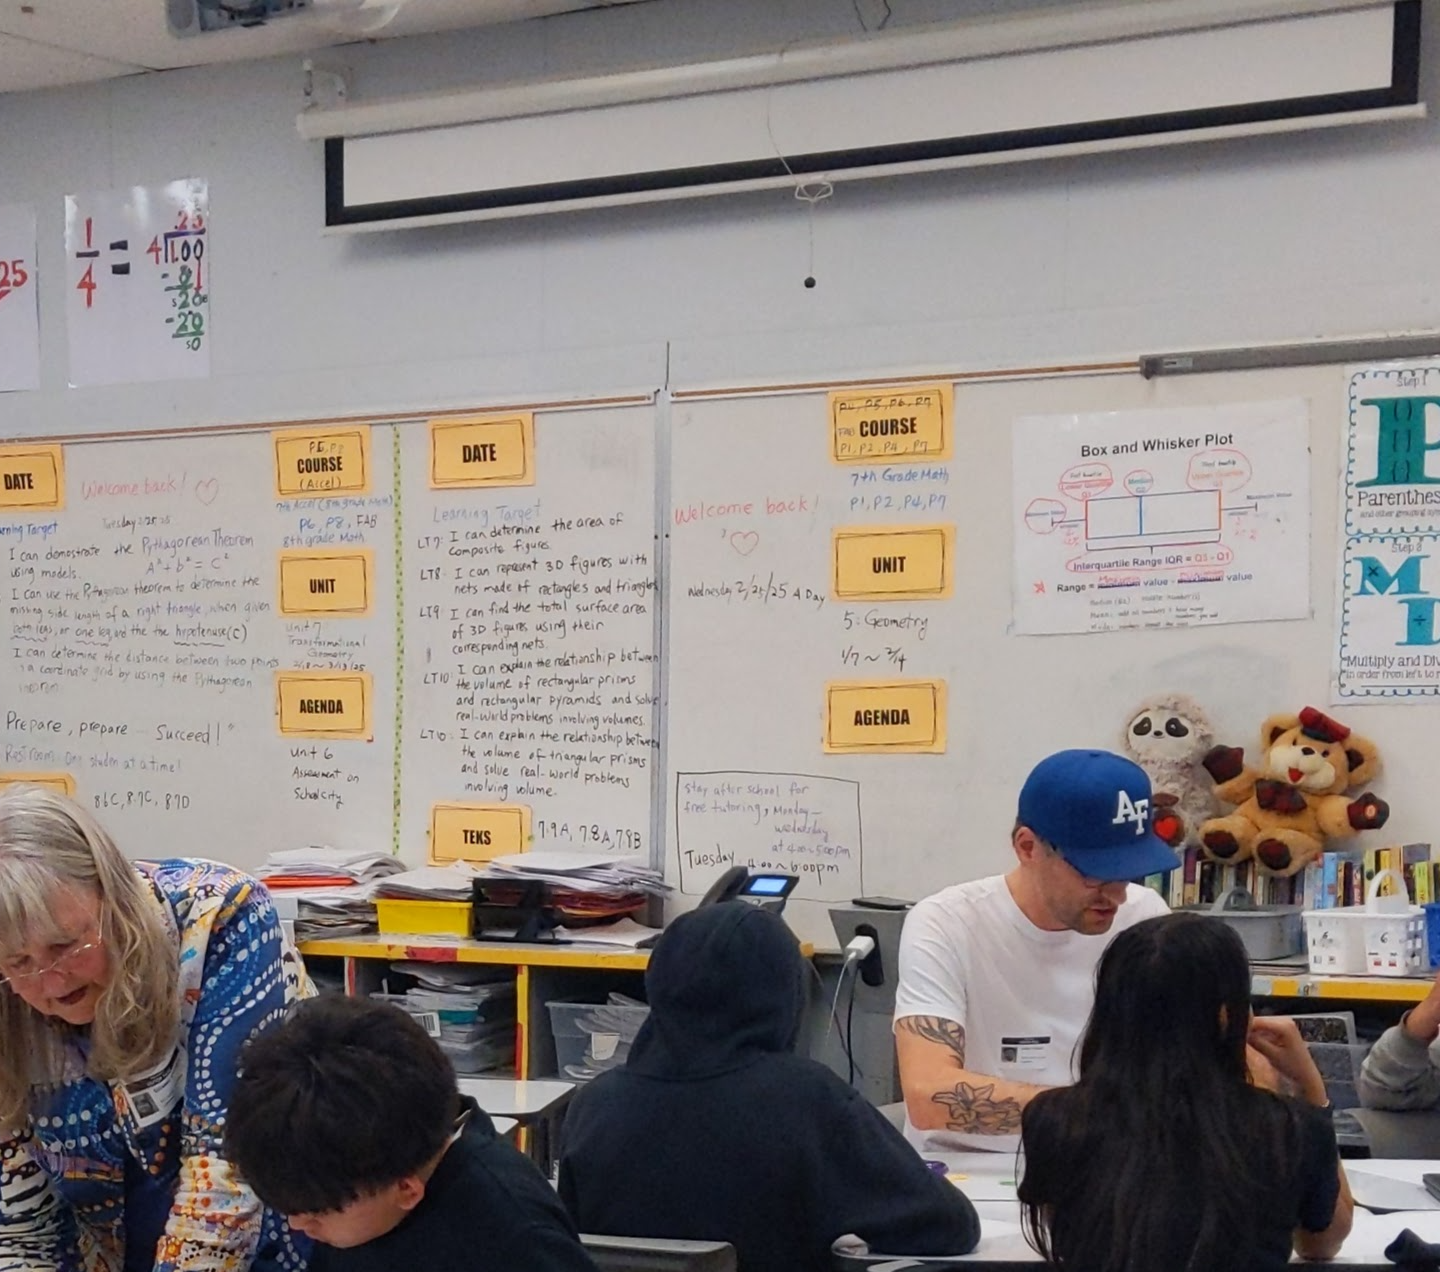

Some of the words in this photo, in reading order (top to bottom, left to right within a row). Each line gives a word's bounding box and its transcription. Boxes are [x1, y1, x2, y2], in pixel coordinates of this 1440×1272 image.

[76, 264, 97, 308] 4
[1396, 377, 1421, 388] Step
[859, 416, 917, 438] COURSE
[462, 443, 497, 464] DATE
[1081, 445, 1108, 457] Box
[1112, 441, 1139, 455] and
[1142, 435, 1200, 452] Whisker
[1205, 433, 1234, 447] Plot
[297, 456, 343, 474] COURSE
[3, 473, 34, 491] DATE
[881, 467, 919, 483] Grade
[920, 467, 950, 485] Math
[433, 506, 489, 528] Learning
[496, 498, 542, 524] Target
[674, 500, 754, 526] Welcome
[1376, 510, 1394, 518] other
[27, 522, 59, 541] Target
[465, 526, 487, 541] can
[490, 520, 541, 539] determine
[552, 517, 573, 531] the
[576, 518, 604, 529] area
[21, 551, 39, 562] can
[212, 527, 254, 548] Theorem
[305, 533, 335, 548] grade
[1391, 542, 1415, 555] Step
[468, 566, 490, 578] can
[497, 559, 539, 577] represent
[569, 554, 613, 576] figures
[618, 553, 648, 566] with
[872, 556, 907, 574] UNIT
[1073, 560, 1130, 572] Interquartile
[1132, 556, 1163, 569] Range
[1165, 555, 1184, 565] IQR
[1216, 551, 1231, 562] Q1
[10, 566, 35, 586] using
[134, 581, 172, 596] theorem
[190, 574, 237, 591] determine
[309, 578, 336, 594] UNIT
[1057, 583, 1087, 595] Range
[1143, 577, 1169, 588] value
[1226, 573, 1253, 583] value
[1351, 554, 1432, 597] M
[454, 581, 479, 595] nets
[483, 579, 513, 593] made
[538, 578, 589, 599] rectangles
[594, 577, 612, 595] and
[10, 606, 42, 624] missing
[137, 601, 162, 621] right
[465, 606, 485, 619] can
[489, 600, 511, 616] find
[512, 601, 532, 614] the
[537, 600, 568, 613] total
[575, 599, 619, 615] surface
[622, 603, 648, 615] area
[470, 623, 487, 636] 3D
[492, 620, 528, 638] figures
[535, 619, 568, 640] using
[572, 618, 605, 632] their
[864, 608, 930, 640] Geometry
[126, 648, 169, 664] distance
[175, 652, 220, 665] between
[471, 663, 495, 676] can
[499, 658, 534, 675] explain
[535, 656, 552, 669] the
[554, 647, 616, 668] relationship
[1346, 655, 1396, 671] Multiply
[1398, 654, 1421, 668] and
[456, 676, 472, 691] the
[473, 676, 513, 690] volume
[537, 674, 595, 692] rectangular
[598, 673, 637, 691] prisms
[1357, 669, 1381, 679] order
[1382, 669, 1405, 679] from
[299, 699, 344, 715] AGENDA
[456, 692, 475, 706] and
[480, 691, 541, 710] rectangular
[549, 692, 602, 710] pyramids
[611, 689, 632, 704] and
[510, 708, 554, 725] problems
[559, 710, 600, 729] involving
[853, 708, 911, 727] AGENDA
[78, 721, 128, 745] prepare
[474, 730, 494, 742] can
[498, 727, 536, 744] explain
[540, 729, 560, 743] the
[563, 726, 624, 748] relationship
[461, 745, 476, 759] the
[483, 744, 521, 760] volume
[549, 749, 607, 769] triangular
[610, 752, 647, 768] prisms
[461, 762, 479, 775] and
[484, 763, 510, 777] solve
[584, 769, 631, 789] problems
[464, 780, 509, 801] involving
[747, 783, 781, 798] school
[788, 782, 810, 796] for
[684, 799, 707, 814] free
[462, 829, 492, 845] TEKS
[684, 844, 736, 869] Tuesday
